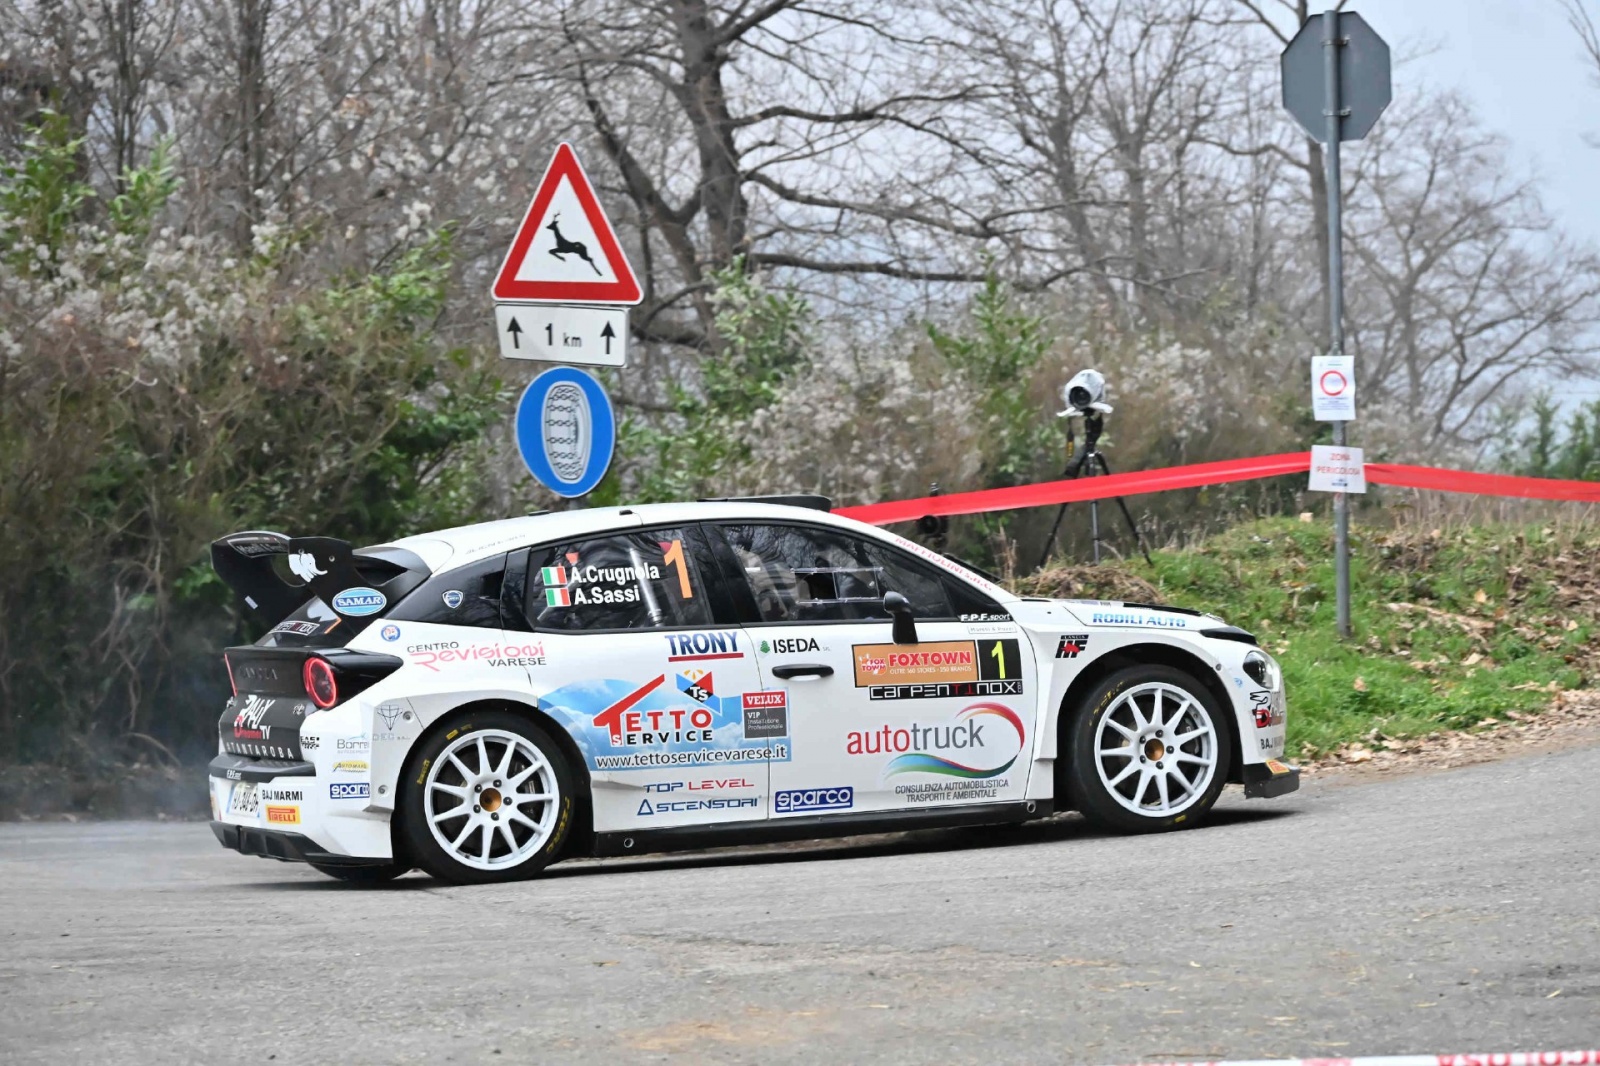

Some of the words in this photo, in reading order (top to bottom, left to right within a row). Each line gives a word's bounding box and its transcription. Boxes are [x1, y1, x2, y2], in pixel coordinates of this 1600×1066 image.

[545, 322, 553, 346] 1
[563, 332, 582, 348] km
[570, 563, 660, 586] A.Crugnola
[664, 539, 693, 599] 1
[337, 595, 381, 607] SAMAR
[574, 585, 641, 605] A.Sassi
[1092, 612, 1143, 625] RODILI
[1146, 616, 1186, 627] AUTO
[406, 641, 460, 653] CENTRO
[664, 631, 738, 656] TRONY
[773, 637, 821, 653] ISEDA
[488, 656, 547, 667] VARESE
[888, 651, 972, 667] FOXTOWN
[991, 641, 1006, 679] 1
[690, 686, 709, 701] TS
[746, 694, 782, 705] VELUX
[747, 711, 761, 719] VIP
[259, 725, 271, 740] TV
[612, 729, 713, 746] SERVICE
[846, 718, 985, 755] autotruck
[596, 745, 786, 768] www.tettoservicevarese.it
[643, 782, 684, 793] TOP
[688, 778, 755, 791] LEVEL
[895, 783, 943, 794] CONSULENZA
[944, 779, 1009, 791] AUTOMOBILISTICA
[262, 789, 273, 800] BAJ
[273, 790, 303, 801] MARMI
[778, 788, 851, 811] sparco
[906, 792, 945, 803] TRASPORTI
[946, 792, 951, 800] E
[952, 789, 997, 800] AMBIENTALE
[268, 808, 296, 822] PIRELLI
